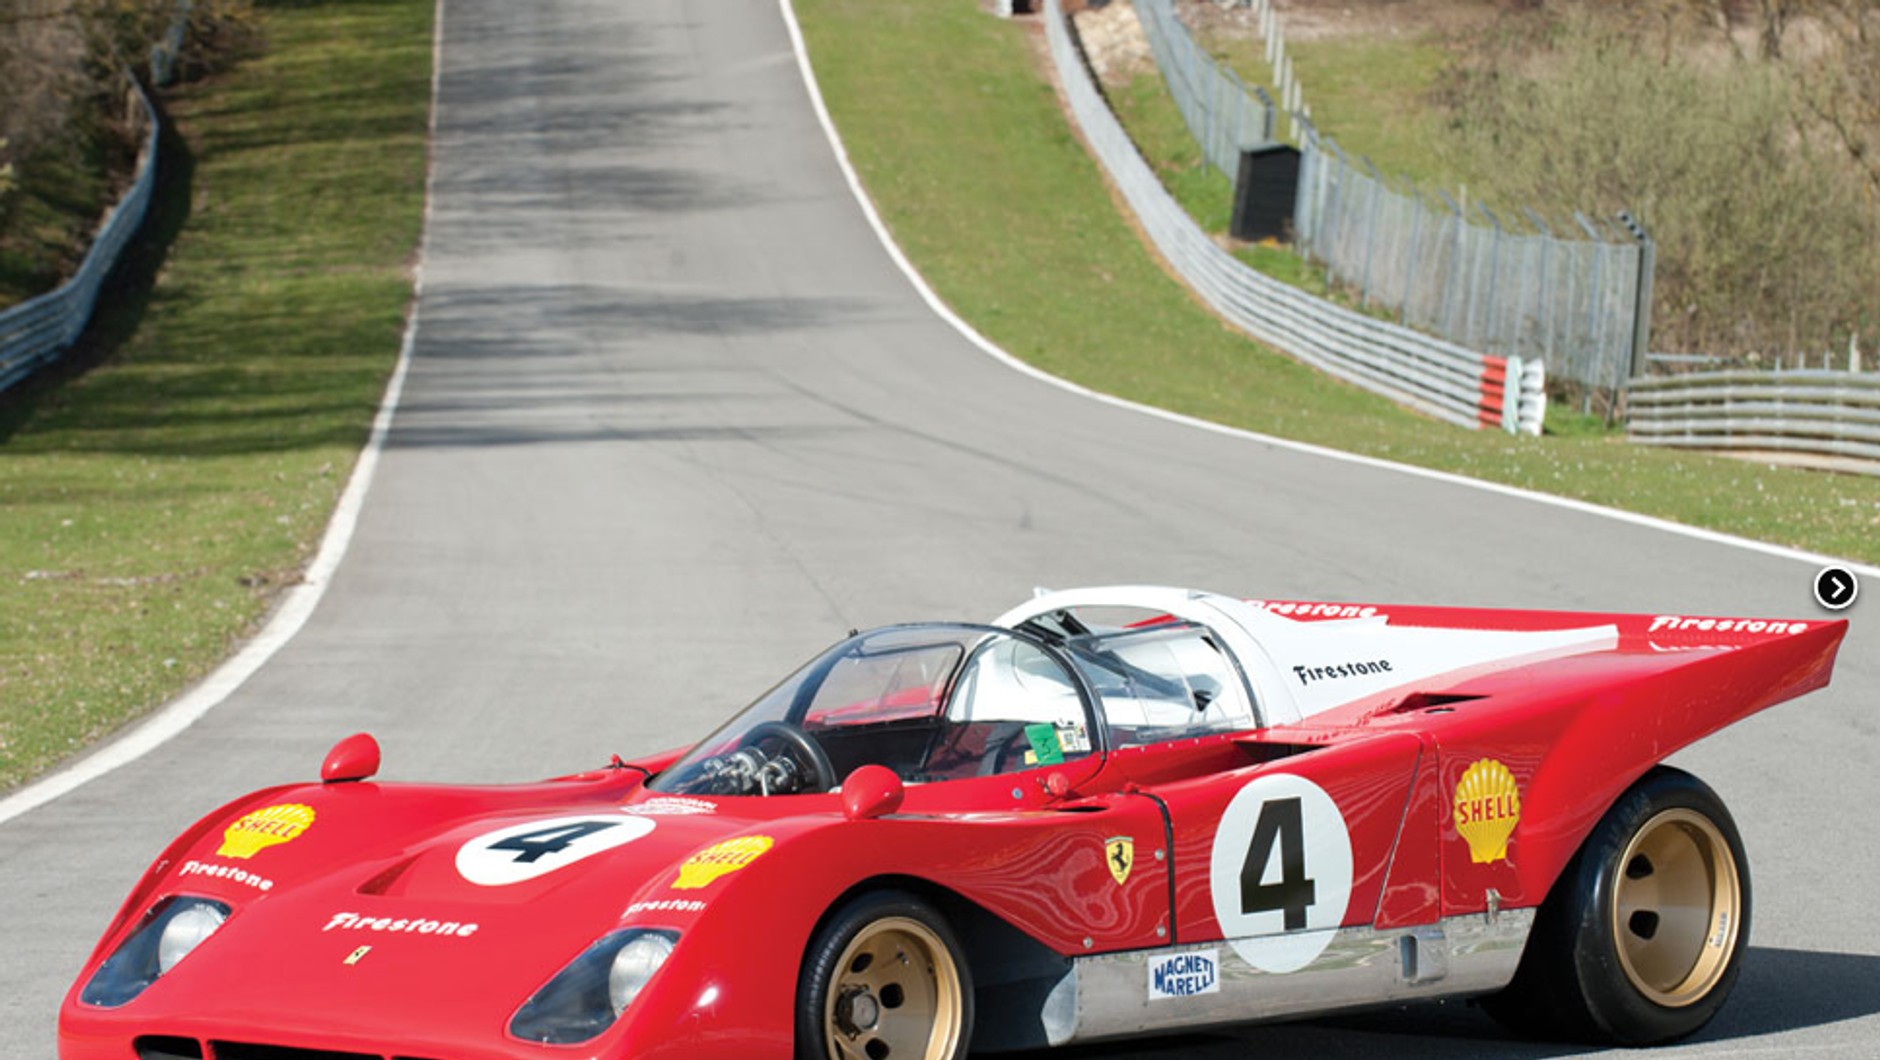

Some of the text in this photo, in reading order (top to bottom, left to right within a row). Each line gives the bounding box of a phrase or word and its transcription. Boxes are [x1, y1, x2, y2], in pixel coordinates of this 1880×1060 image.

[1251, 600, 1378, 618] restone
[1649, 616, 1808, 635] Firestone
[1293, 659, 1393, 686] Firestone
[1458, 794, 1516, 825] SHELL
[233, 818, 296, 838] SHELL
[485, 820, 623, 863] 4
[689, 851, 758, 866] SHELL
[1240, 796, 1316, 931] 4
[178, 860, 274, 891] Firestone
[620, 899, 707, 920] Fireston
[322, 912, 479, 937] Firestone
[1154, 955, 1214, 984] MAGNETI
[1154, 974, 1214, 996] MARELLI
